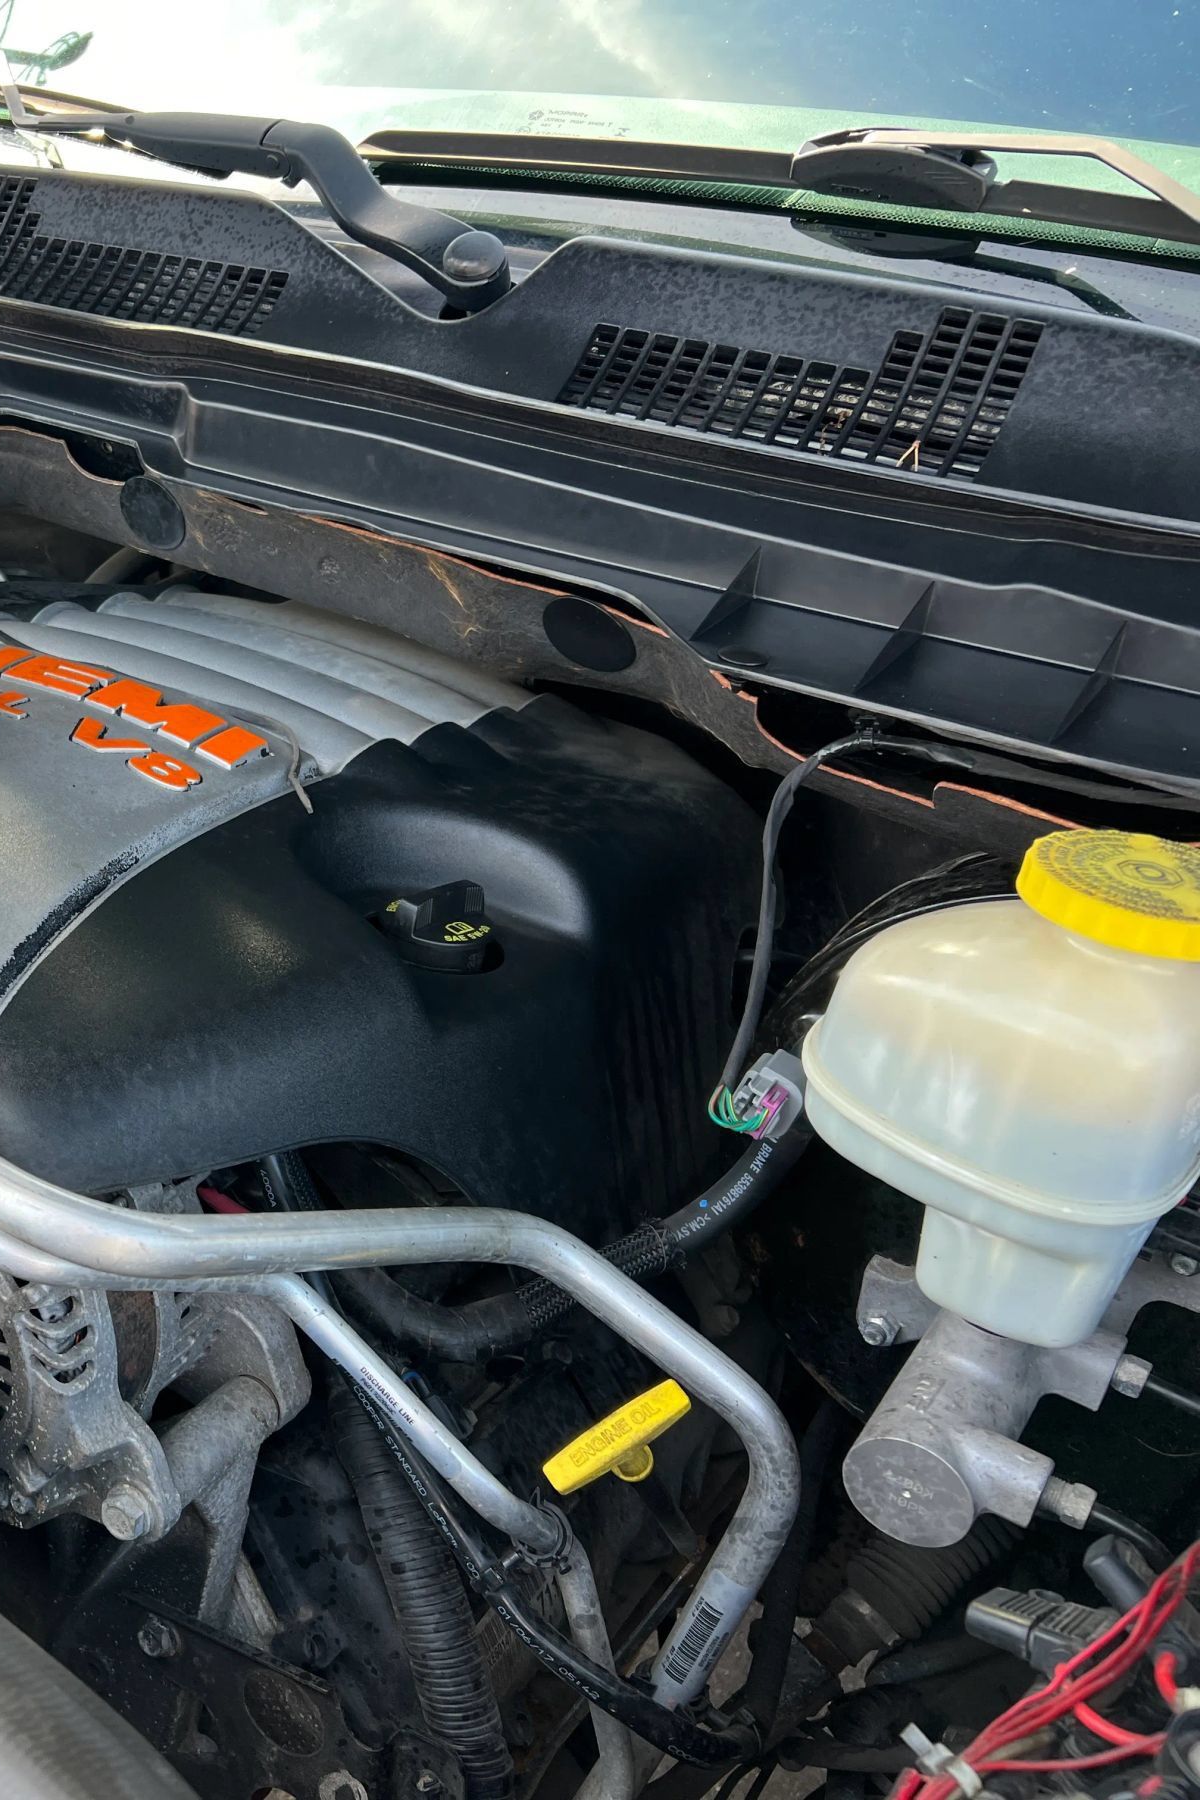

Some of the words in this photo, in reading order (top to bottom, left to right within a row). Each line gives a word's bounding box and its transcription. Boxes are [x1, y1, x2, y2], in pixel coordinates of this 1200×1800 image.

[69, 716, 203, 792] V8
[750, 1142, 773, 1174] BRAKE
[360, 1366, 399, 1408] DISCHARGE
[399, 1408, 415, 1426] LINE
[353, 1385, 385, 1430] COOPER
[385, 1435, 427, 1497] STANDARD
[569, 1417, 633, 1468] ENGINE
[629, 1401, 661, 1425] OIL
